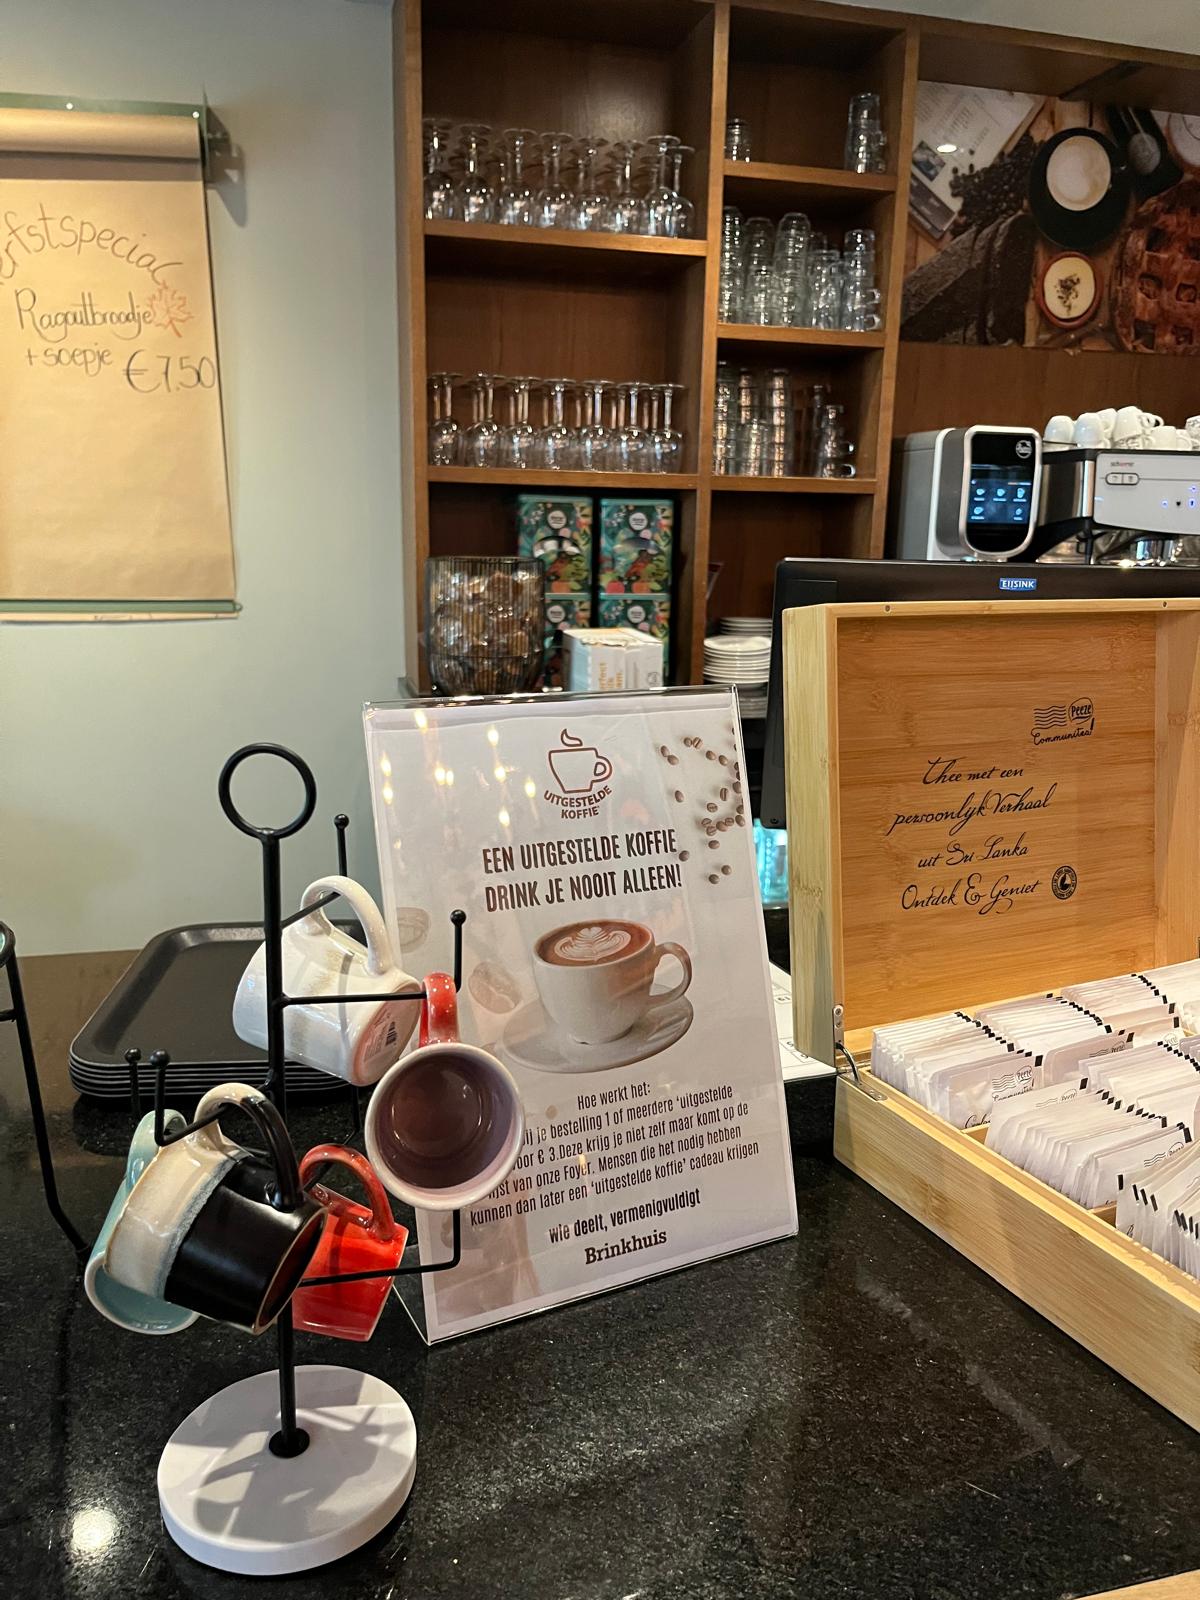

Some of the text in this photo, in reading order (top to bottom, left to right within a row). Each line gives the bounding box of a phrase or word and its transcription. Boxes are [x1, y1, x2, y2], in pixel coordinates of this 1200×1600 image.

[922, 757, 1024, 785] Thee met een
[543, 785, 612, 808] UITGESTELDE
[561, 806, 600, 819] KOFFIE
[985, 782, 1058, 814] Verhaal
[482, 828, 678, 874] EEN UITGESTELDE KOFFIE
[917, 832, 1029, 868] uit Sri Lanka
[485, 863, 682, 912] DRINK JE NOOIT ALLEEN!
[901, 879, 963, 910] Ontdek
[964, 872, 988, 906] &
[978, 874, 1043, 915] Geniet
[577, 1081, 651, 1110] Hoe werkt het:
[513, 1153, 534, 1170] oor
[537, 1149, 545, 1164] €
[586, 1135, 610, 1153] krijg
[613, 1128, 623, 1149] je
[626, 1123, 646, 1144] niet
[649, 1121, 666, 1138] zelf
[669, 1115, 694, 1134] maar
[696, 1108, 721, 1127] komt
[723, 1105, 735, 1121] op
[737, 1102, 749, 1118] de
[522, 1128, 534, 1146] ij
[537, 1126, 547, 1144] je
[550, 1115, 602, 1139] bestelling
[605, 1111, 610, 1126] 1
[613, 1108, 624, 1125] of
[627, 1099, 674, 1122] meerdere
[513, 1176, 533, 1193] van
[536, 1169, 560, 1188] onze
[564, 1161, 595, 1181] Foyer.
[598, 1149, 638, 1175] Mensen
[640, 1145, 656, 1162] die
[658, 1140, 675, 1157] het
[677, 1132, 704, 1153] nodig
[707, 1125, 742, 1145] hebben
[470, 1203, 513, 1226] kunnen
[516, 1197, 537, 1215] dan
[540, 1190, 565, 1209] later
[568, 1184, 588, 1202] een
[690, 1149, 724, 1171] cadeau
[726, 1141, 760, 1162] krijgen
[549, 1187, 701, 1244] wie deelt, vermenigvuldigt
[584, 1229, 668, 1265] Brinkhuis
